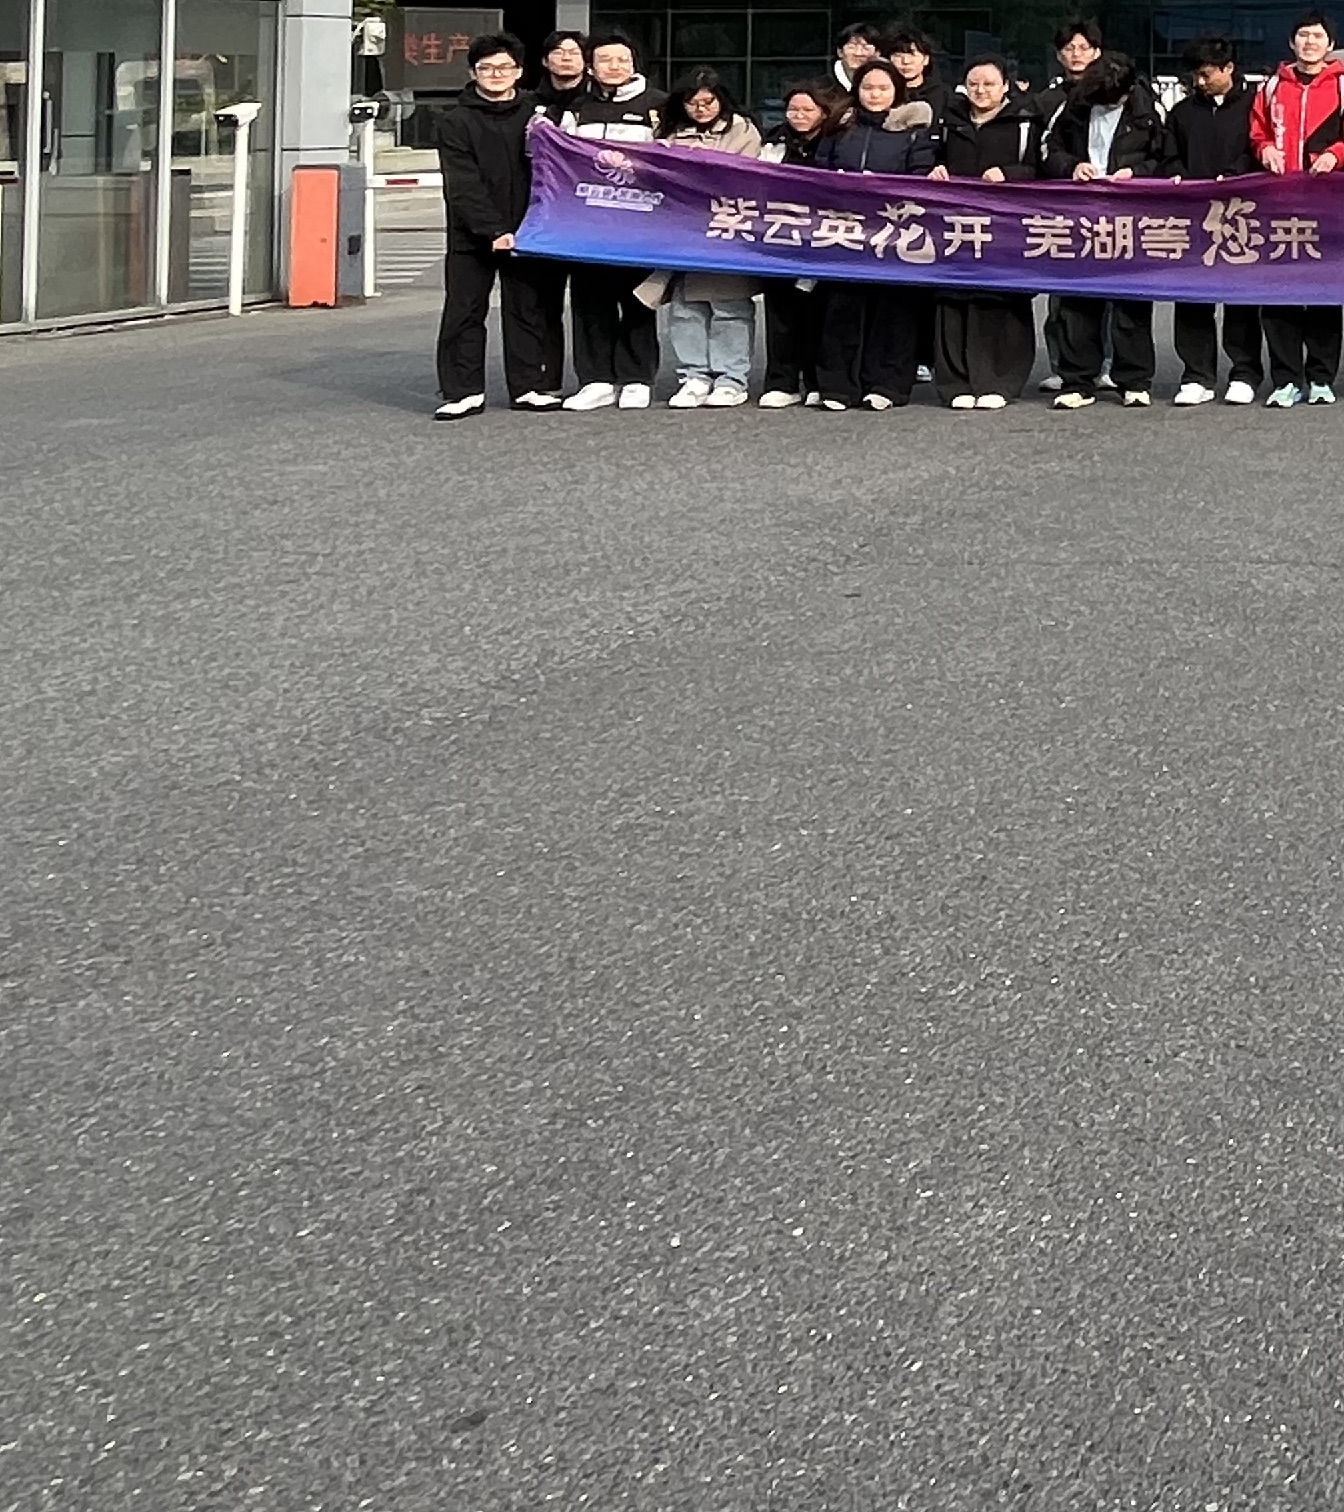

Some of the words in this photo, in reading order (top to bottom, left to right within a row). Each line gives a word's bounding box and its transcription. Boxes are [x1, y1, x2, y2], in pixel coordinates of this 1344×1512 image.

[707, 197, 993, 264] 紫云英花开
[1022, 198, 1321, 265] 芜湖等您来
